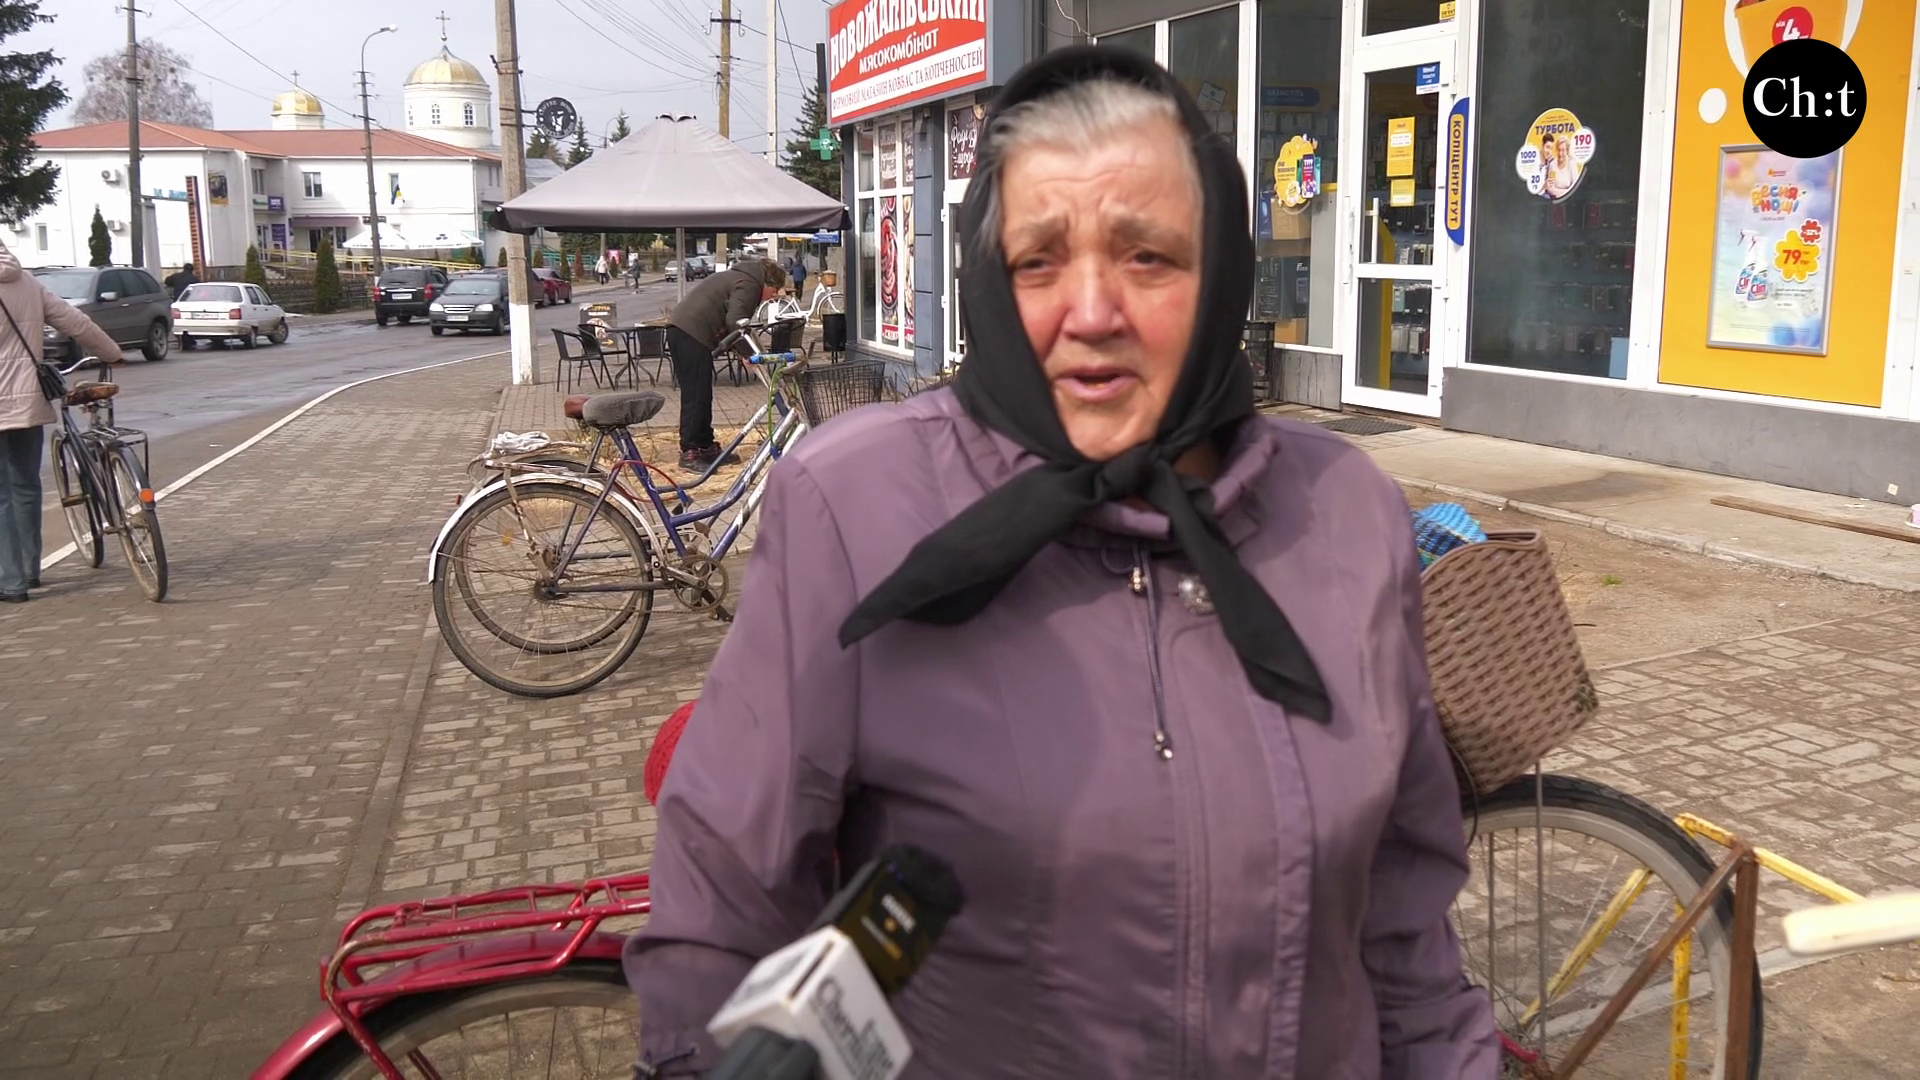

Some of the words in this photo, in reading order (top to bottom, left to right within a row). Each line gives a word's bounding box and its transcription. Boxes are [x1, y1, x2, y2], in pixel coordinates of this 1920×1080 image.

[1782, 17, 1801, 41] 4
[924, 46, 983, 81] КОПЧЕНОСТЕЙ
[1535, 123, 1575, 135] ТУРБОТА
[1574, 133, 1592, 146] 190
[1450, 120, 1462, 196] КОПІЦЕНТР
[1520, 150, 1537, 159] 1000
[1531, 175, 1541, 184] 20
[1450, 200, 1461, 223] ТУТ
[1782, 249, 1802, 265] 79
